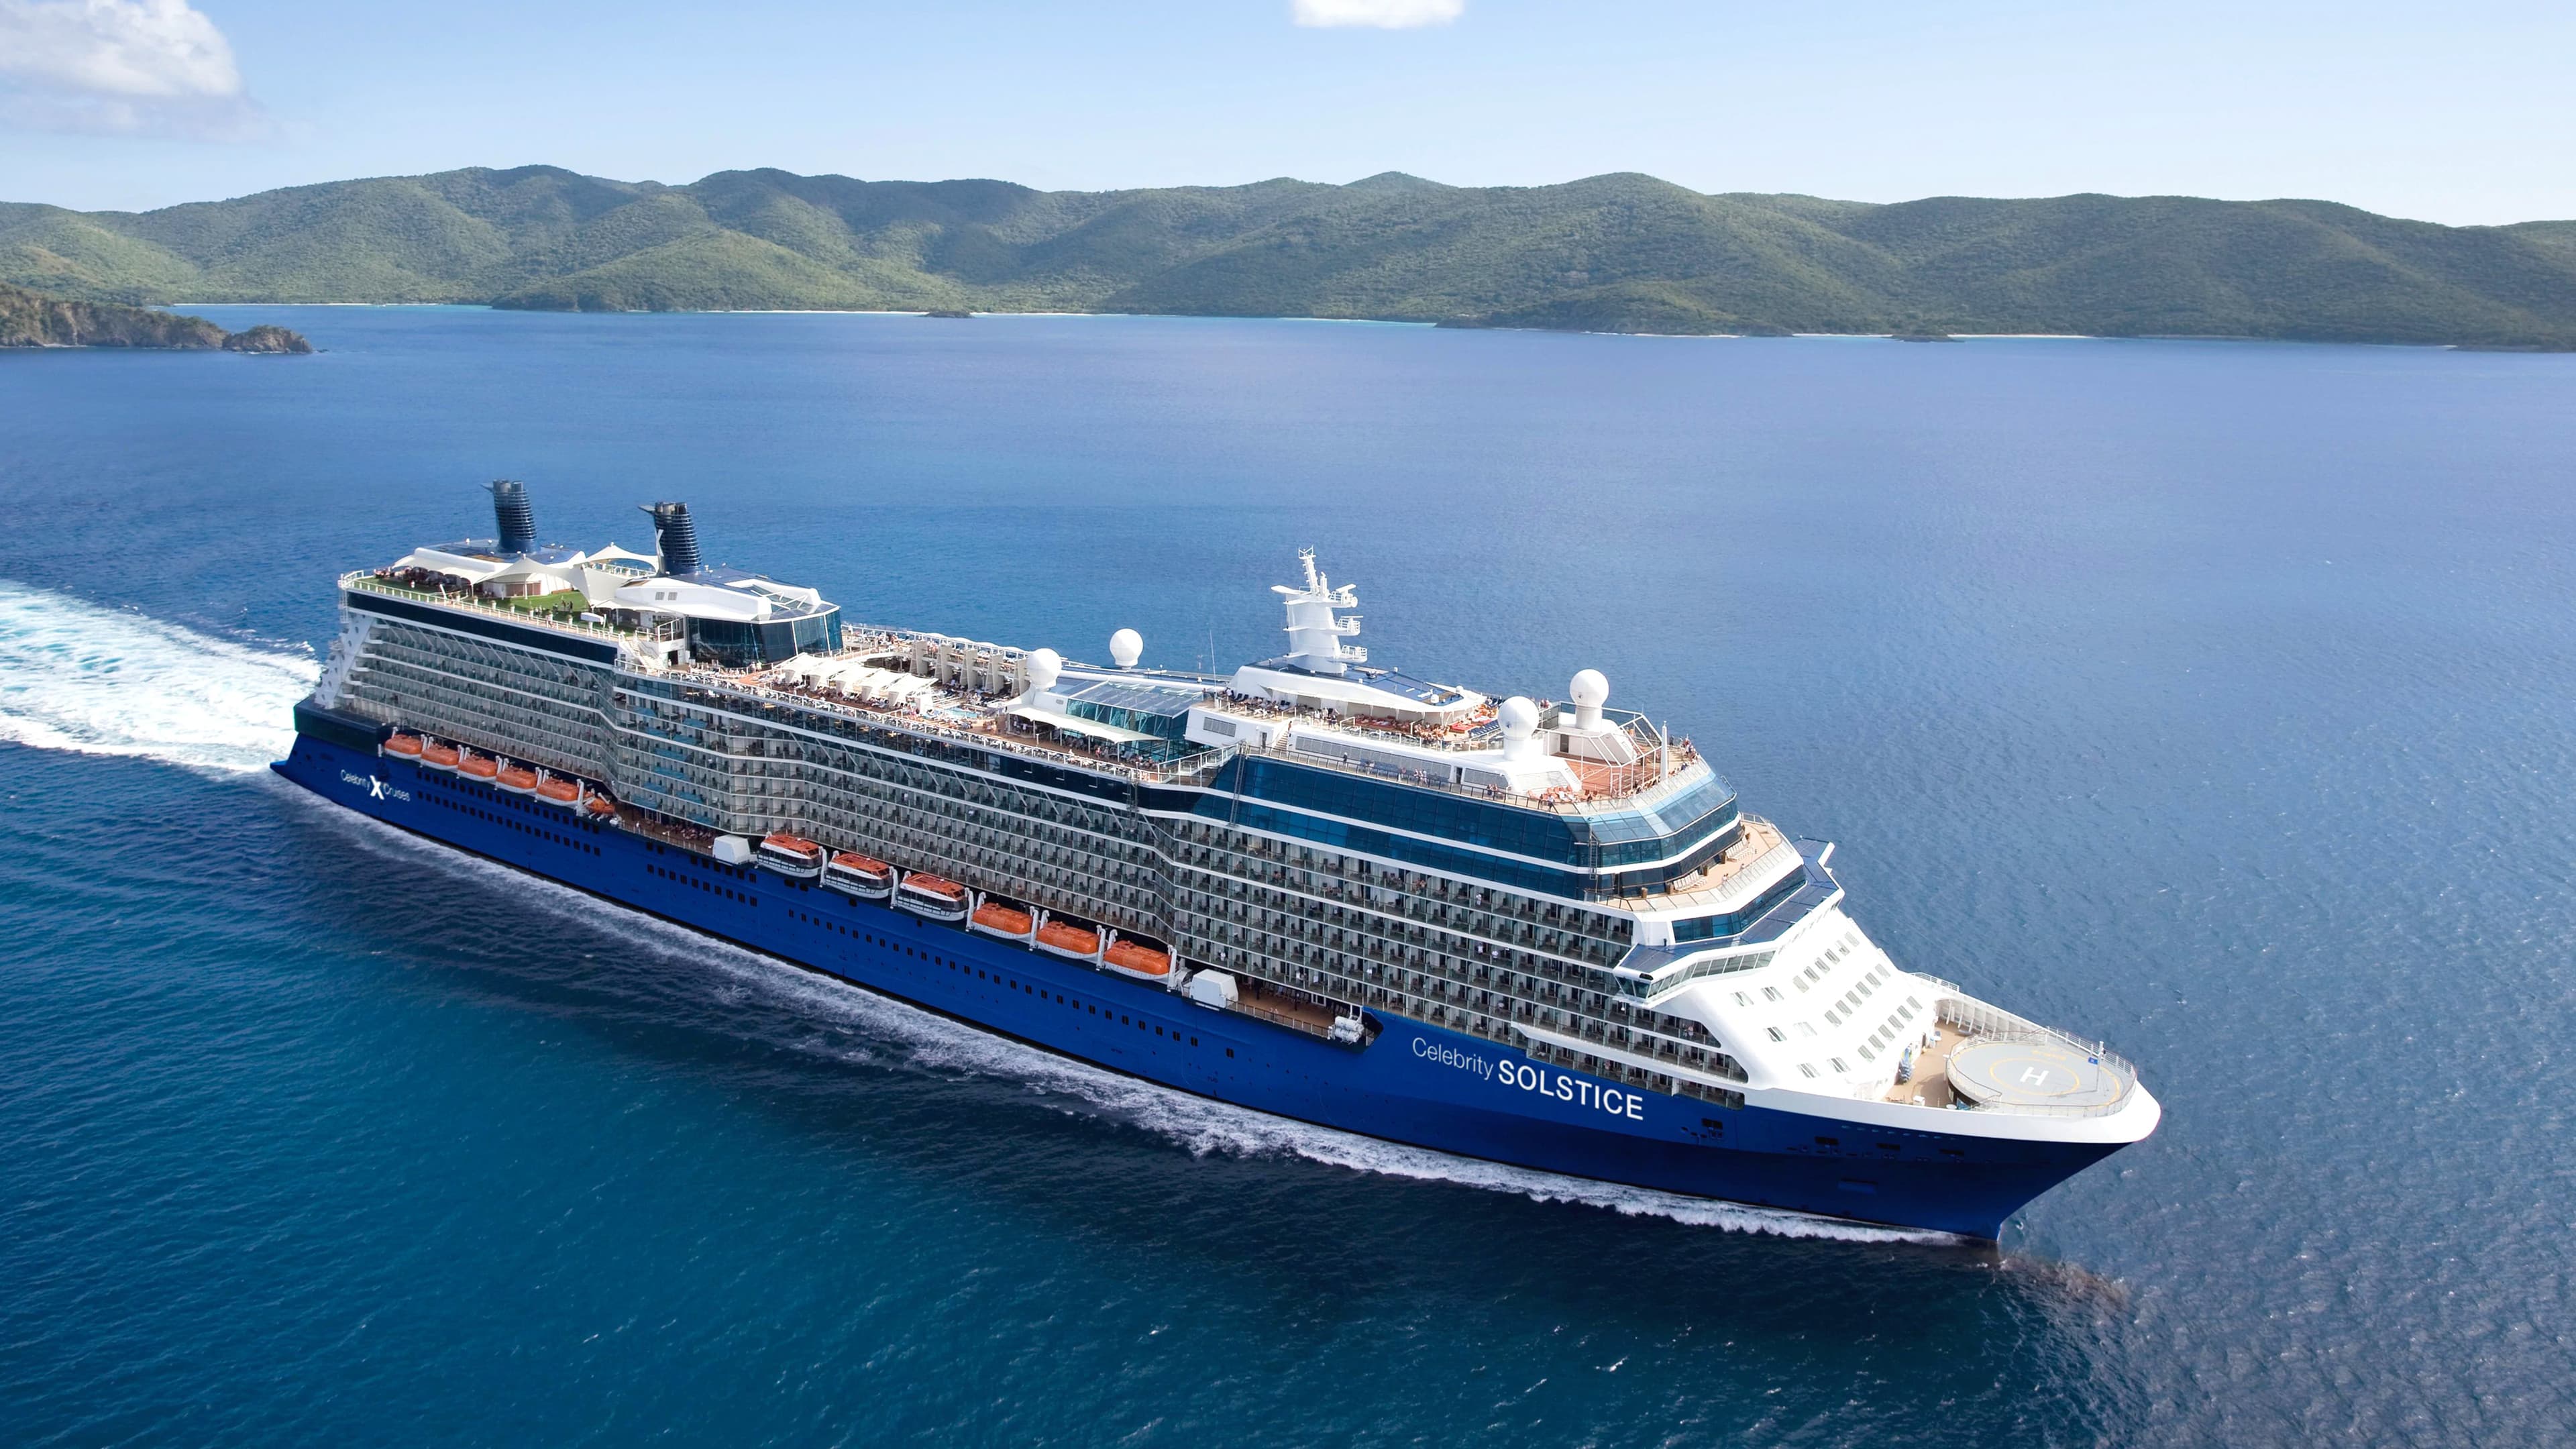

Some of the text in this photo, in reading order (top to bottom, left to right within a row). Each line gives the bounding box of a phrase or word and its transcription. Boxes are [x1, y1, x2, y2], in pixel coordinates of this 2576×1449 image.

[340, 769, 371, 791] Celebrity
[383, 783, 411, 802] Cruises
[1412, 1037, 1644, 1121] Celebrity SOLSTICE
[2019, 1066, 2050, 1086] H
